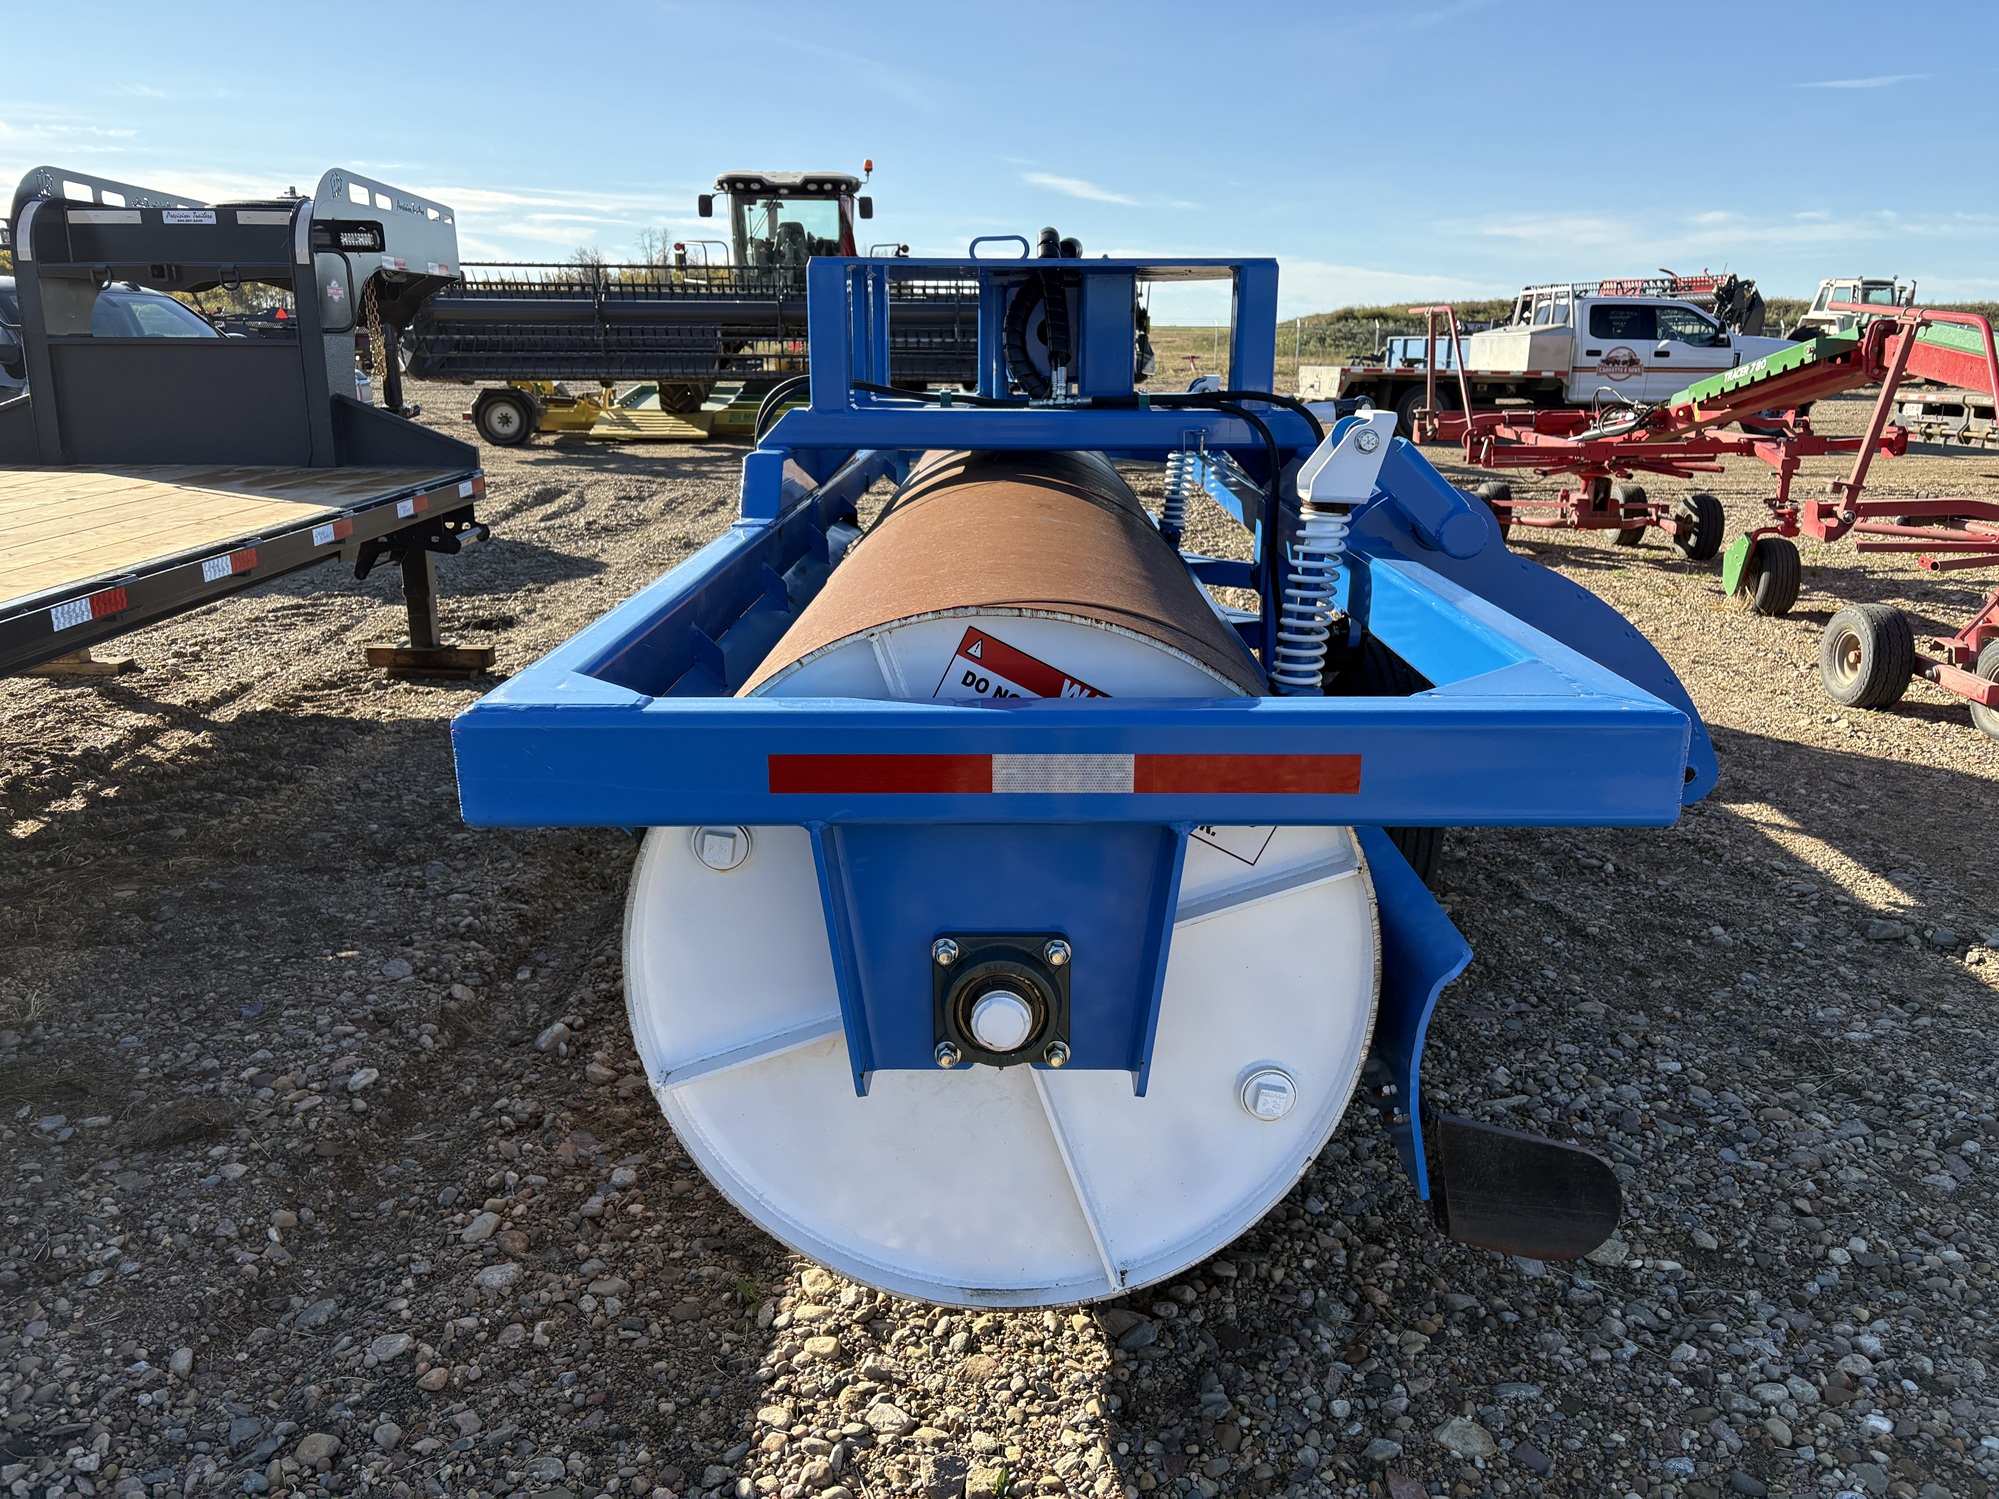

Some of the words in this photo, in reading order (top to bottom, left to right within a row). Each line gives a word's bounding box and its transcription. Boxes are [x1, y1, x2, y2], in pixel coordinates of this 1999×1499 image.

[1723, 365, 1750, 383] TRACER
[1750, 358, 1767, 374] 780
[961, 671, 989, 693] DO
